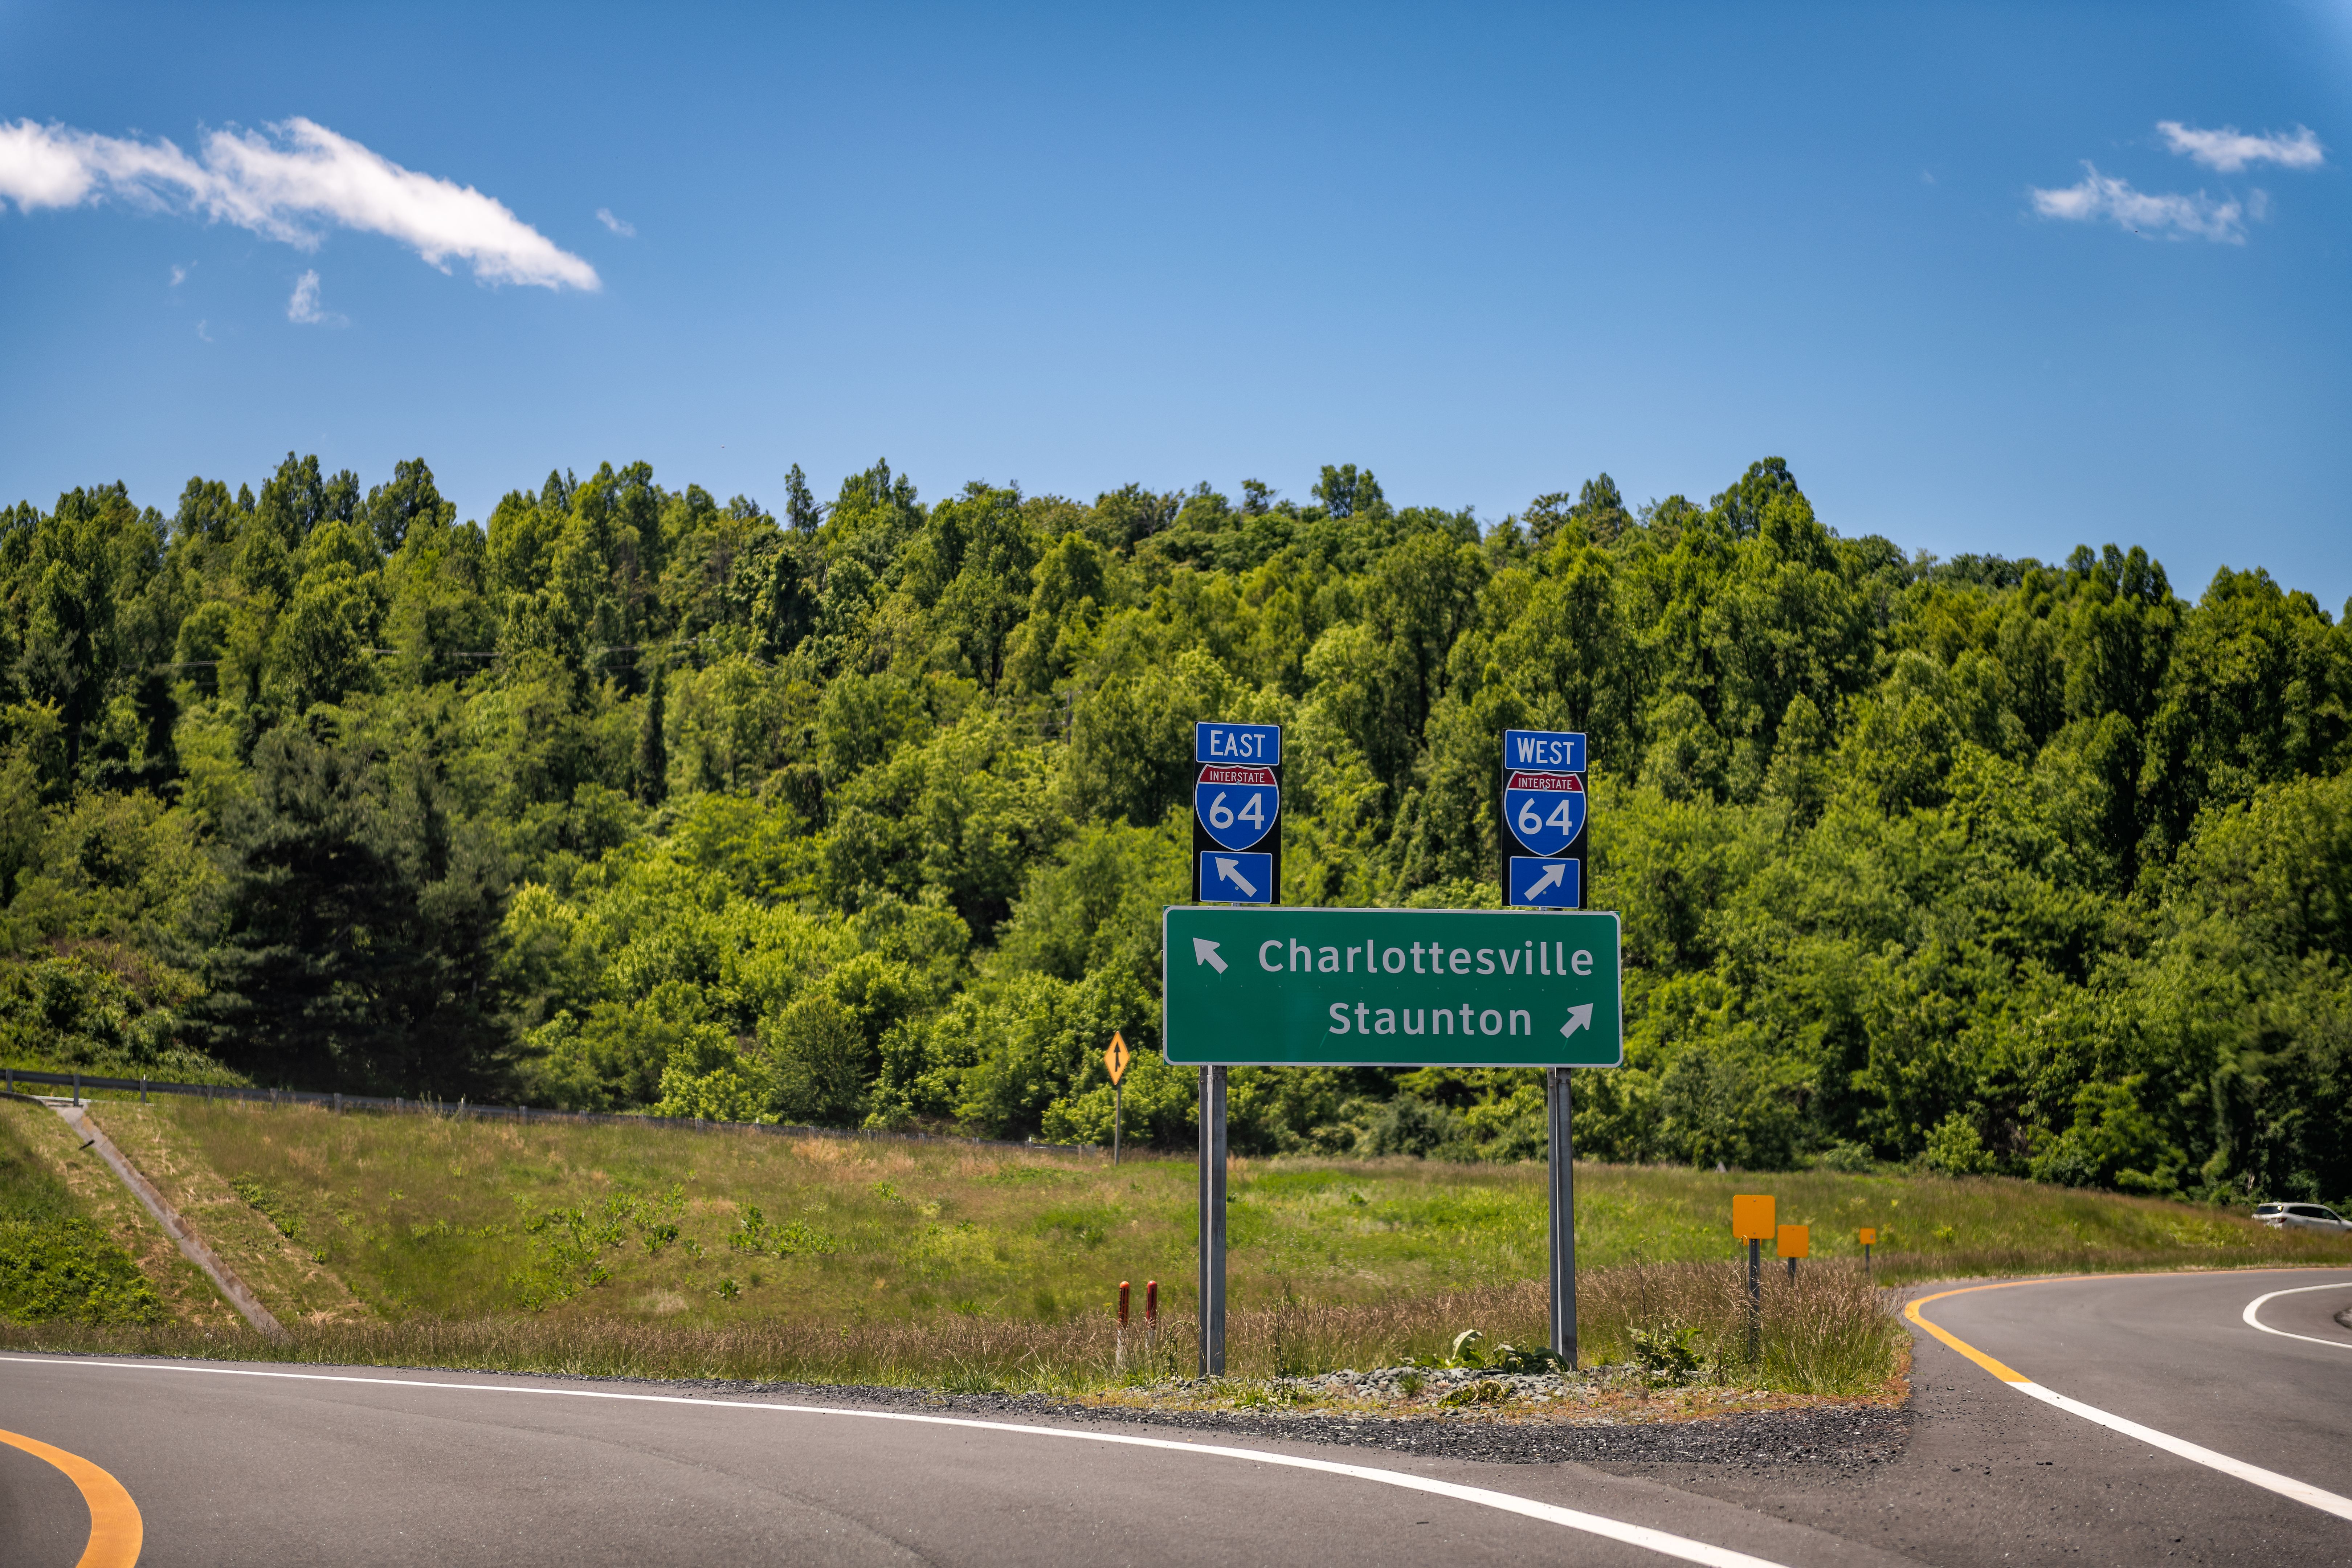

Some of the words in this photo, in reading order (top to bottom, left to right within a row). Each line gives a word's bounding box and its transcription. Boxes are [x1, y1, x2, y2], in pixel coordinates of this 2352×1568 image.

[1210, 730, 1265, 758] EAST
[1516, 737, 1575, 765] WEST
[1210, 771, 1265, 783] INTERSTATE
[1519, 777, 1572, 789] INTERSTATE
[1209, 791, 1265, 830] 64
[1518, 797, 1573, 836] 64
[1259, 938, 1593, 976] Charlottesville
[1329, 1002, 1531, 1036] Staunton
